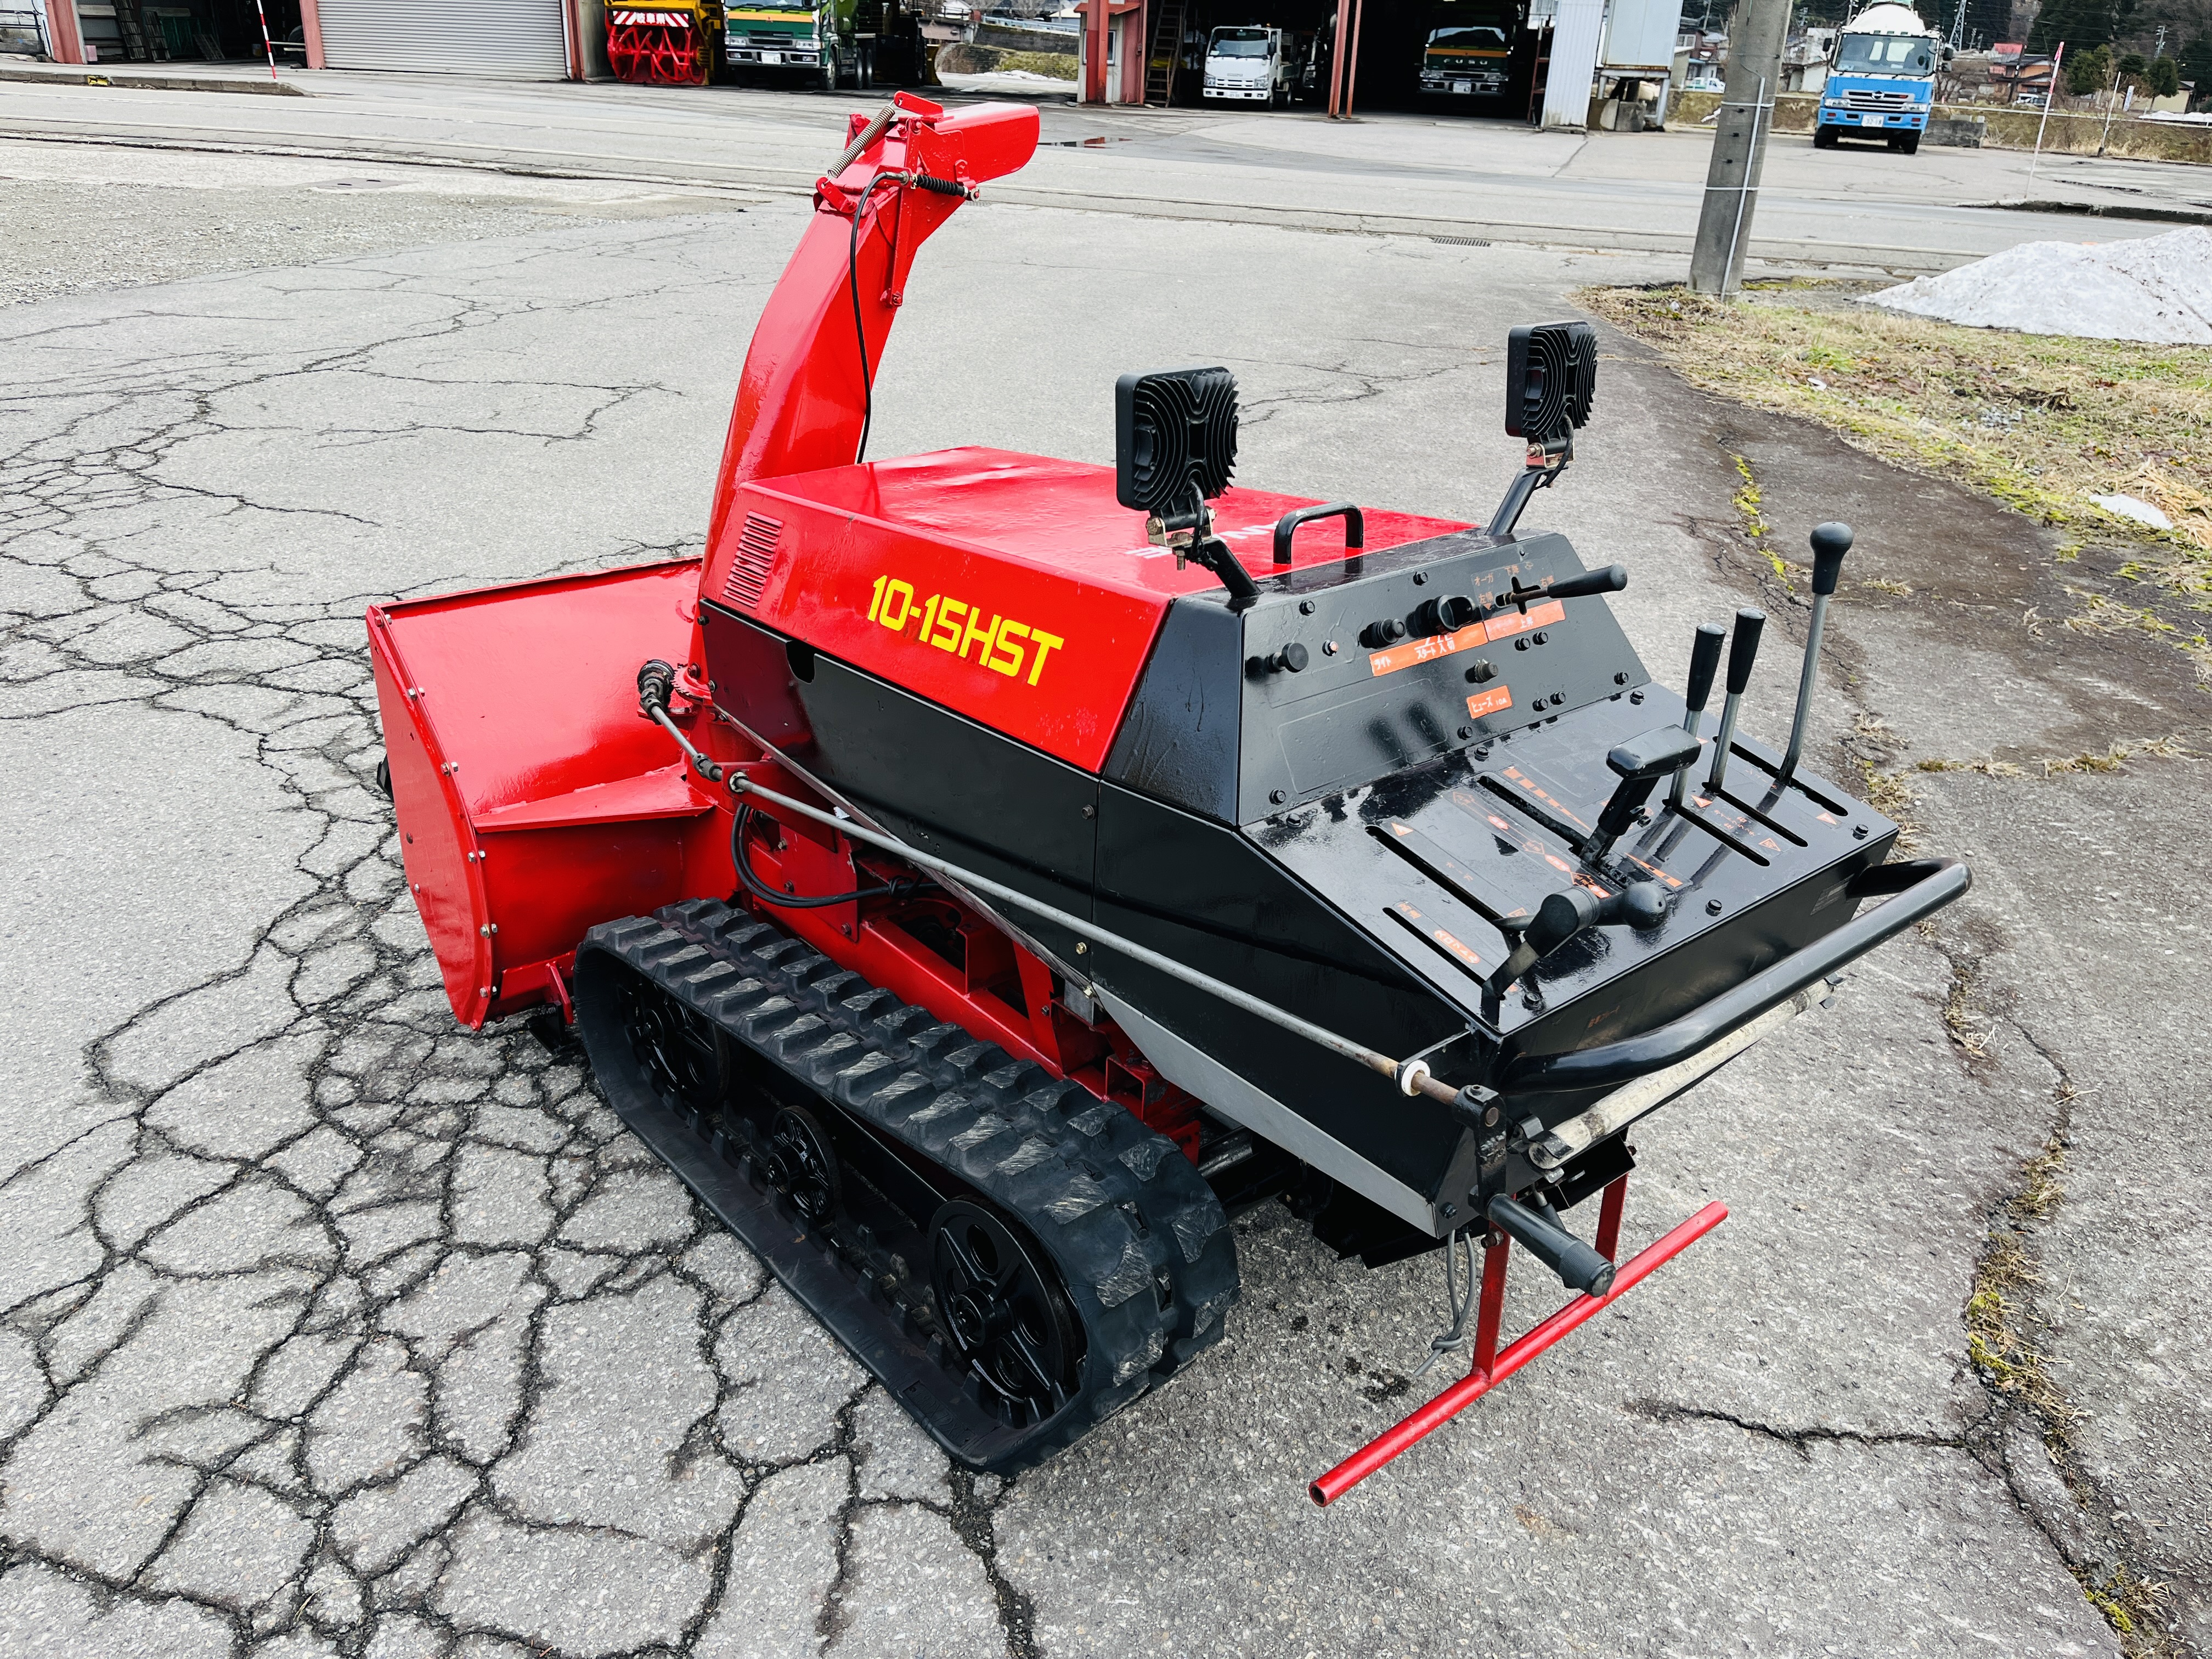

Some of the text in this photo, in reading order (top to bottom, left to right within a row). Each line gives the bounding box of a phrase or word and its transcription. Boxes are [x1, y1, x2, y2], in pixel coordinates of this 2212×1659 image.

[867, 574, 1064, 687] 10-15HST
[1471, 695, 1493, 713] ヒューズ
[1435, 930, 1477, 963] スロットル
